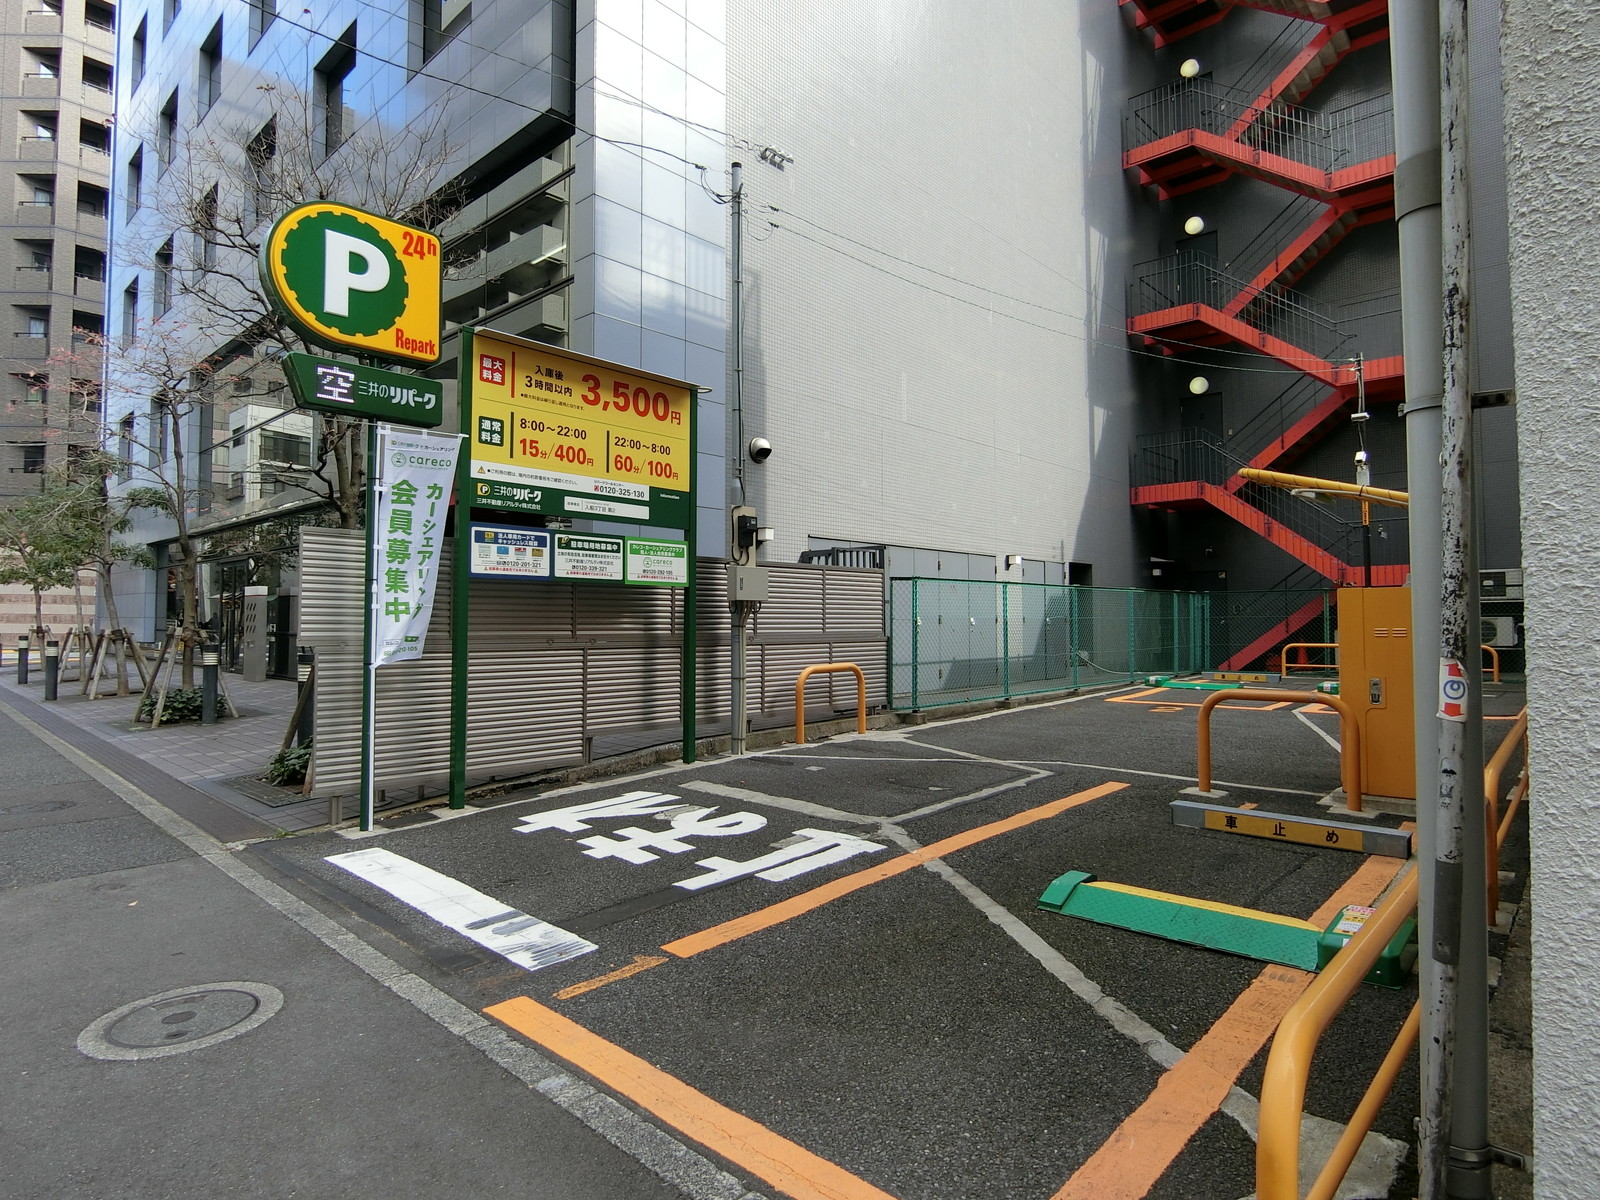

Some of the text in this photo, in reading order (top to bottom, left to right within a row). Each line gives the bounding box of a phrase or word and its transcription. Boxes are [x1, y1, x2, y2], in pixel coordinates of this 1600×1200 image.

[402, 231, 437, 260] 24h
[323, 228, 391, 318] P
[395, 328, 436, 356] Repark
[482, 357, 503, 371] 最大
[482, 369, 503, 383] 料金
[535, 364, 564, 381] 入庫後
[316, 366, 355, 403] 空
[358, 379, 436, 410] 三井のリパーク
[525, 375, 573, 397] 3時間以内
[581, 374, 681, 425] 3,500円
[481, 419, 502, 432] 通常
[481, 431, 502, 444] 料金
[409, 455, 452, 467] careco
[520, 438, 594, 466] 15分/400円
[614, 454, 679, 481] 60分/100円
[494, 485, 542, 502] 三井のリパーク
[385, 479, 419, 622] 会員募集中
[1224, 815, 1339, 844] 車止め
